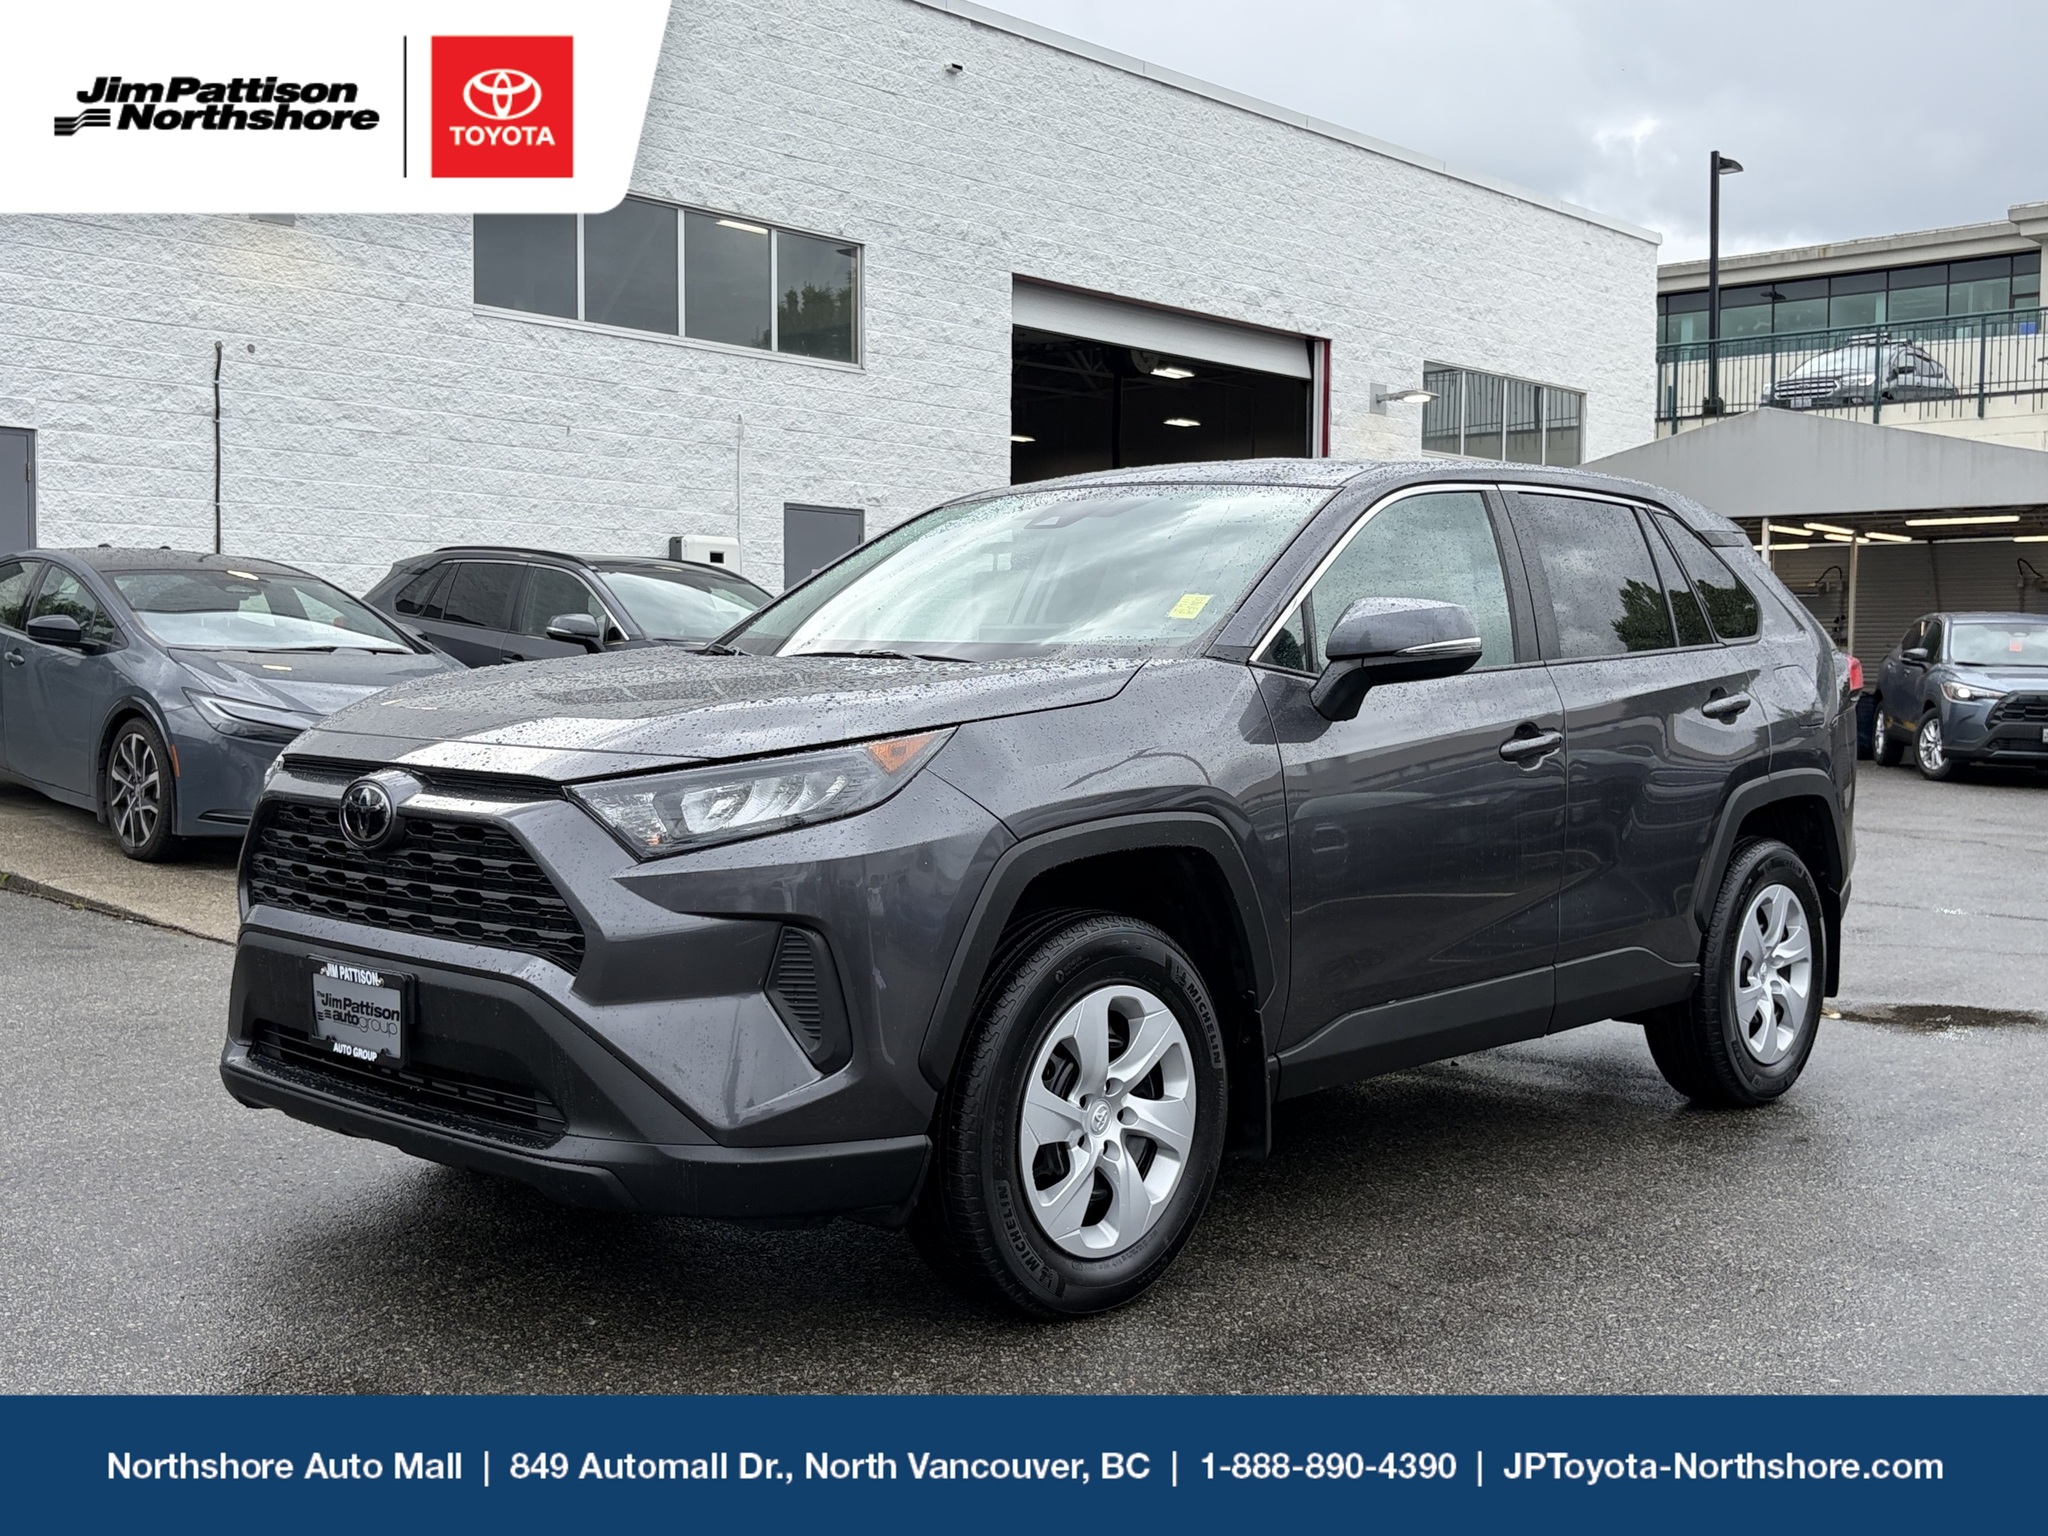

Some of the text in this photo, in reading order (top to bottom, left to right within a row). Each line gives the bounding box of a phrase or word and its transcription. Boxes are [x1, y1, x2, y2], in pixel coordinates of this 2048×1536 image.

[326, 963, 381, 987] JIM PATTISON
[1187, 983, 1222, 1064] MICHELIN
[333, 1042, 377, 1062] AUTO GROUP
[998, 1185, 1040, 1272] MICHELIN
